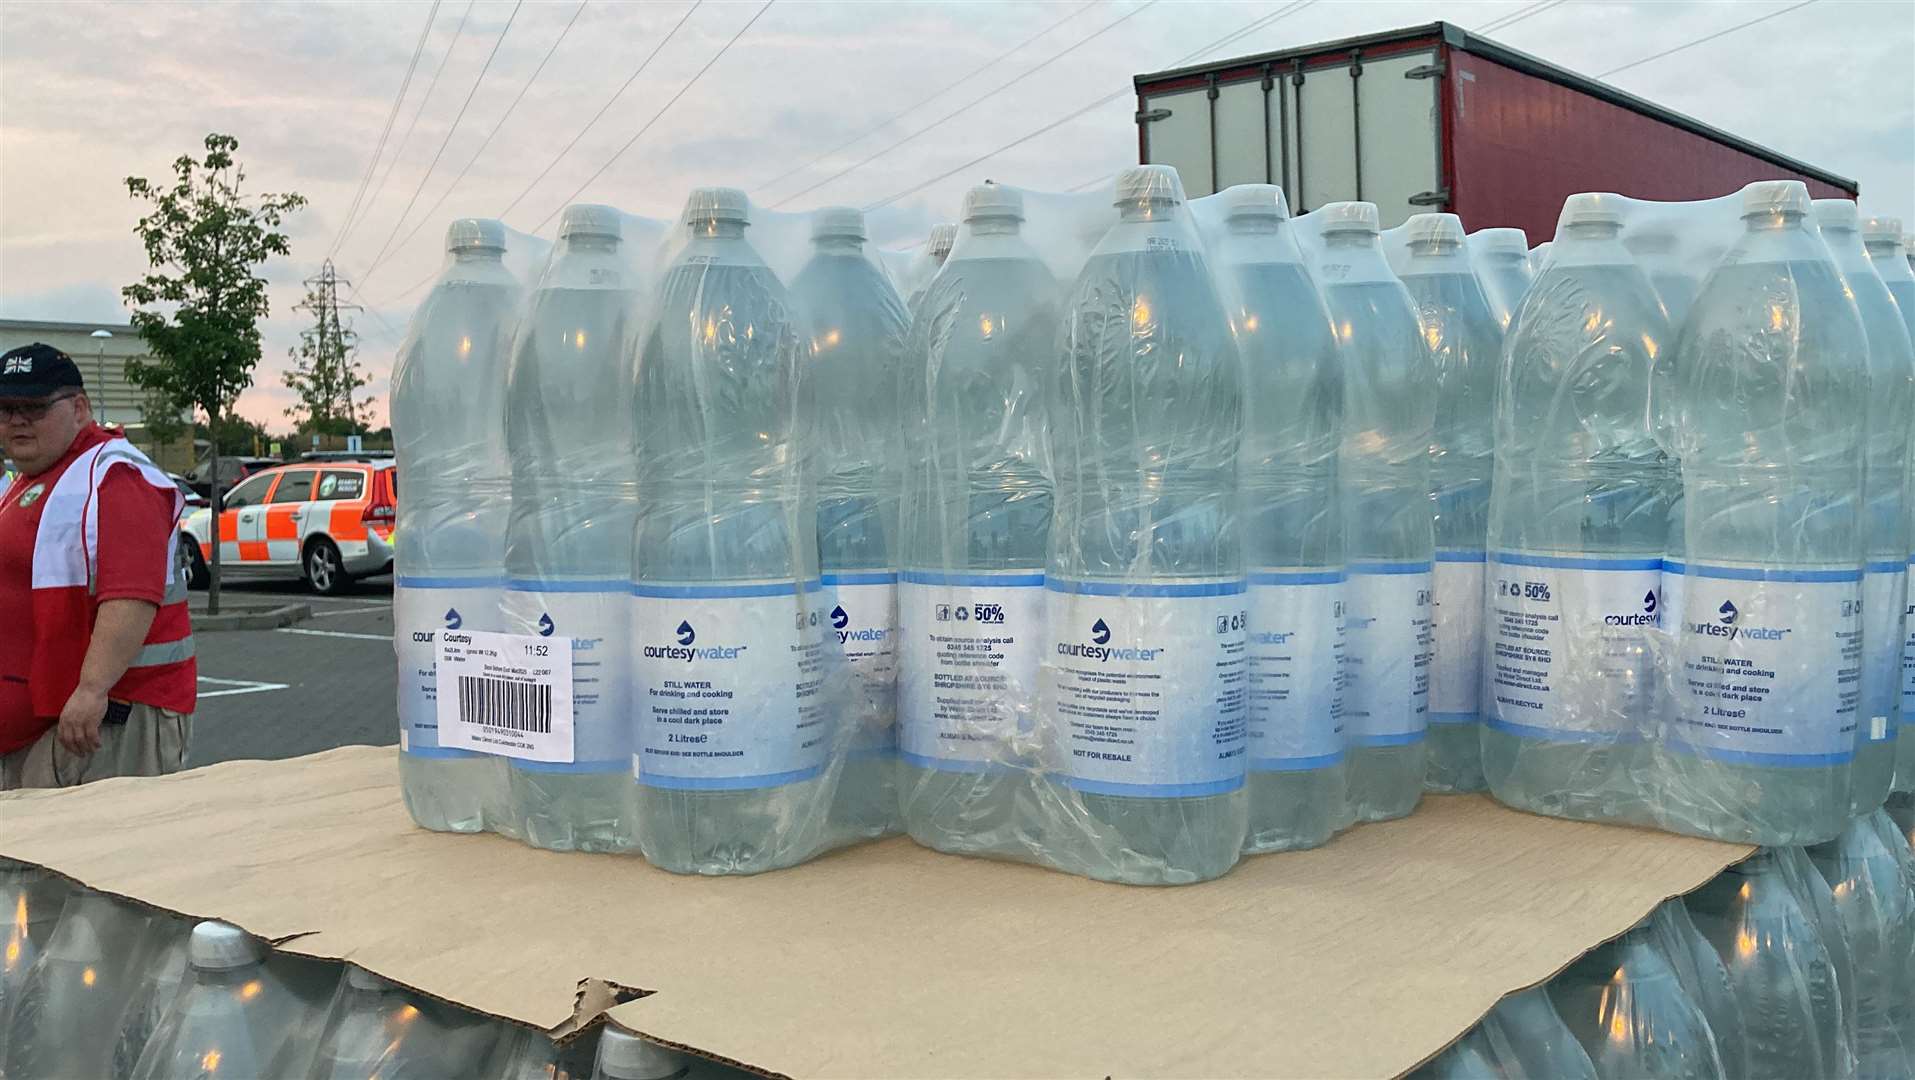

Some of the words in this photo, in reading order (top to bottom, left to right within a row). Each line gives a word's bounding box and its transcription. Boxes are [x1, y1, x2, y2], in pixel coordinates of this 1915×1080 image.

[1525, 585, 1550, 599] 50%
[975, 606, 1004, 621] 50%
[443, 632, 472, 645] Courtesy
[524, 645, 548, 656] 11:52
[1724, 658, 1752, 666] WATER
[1743, 668, 1775, 678] cooking
[650, 688, 658, 696] For
[659, 690, 685, 698] drinking
[702, 690, 733, 698] cooking
[1732, 684, 1747, 692] and
[1749, 685, 1770, 693] store
[1722, 692, 1738, 700] dark
[1741, 693, 1762, 702] place
[652, 706, 668, 714] Serve
[1704, 706, 1709, 714] 2
[702, 717, 722, 725] place
[668, 734, 673, 742] 2
[1087, 751, 1100, 759] FOR
[1102, 753, 1131, 761] RESALE
